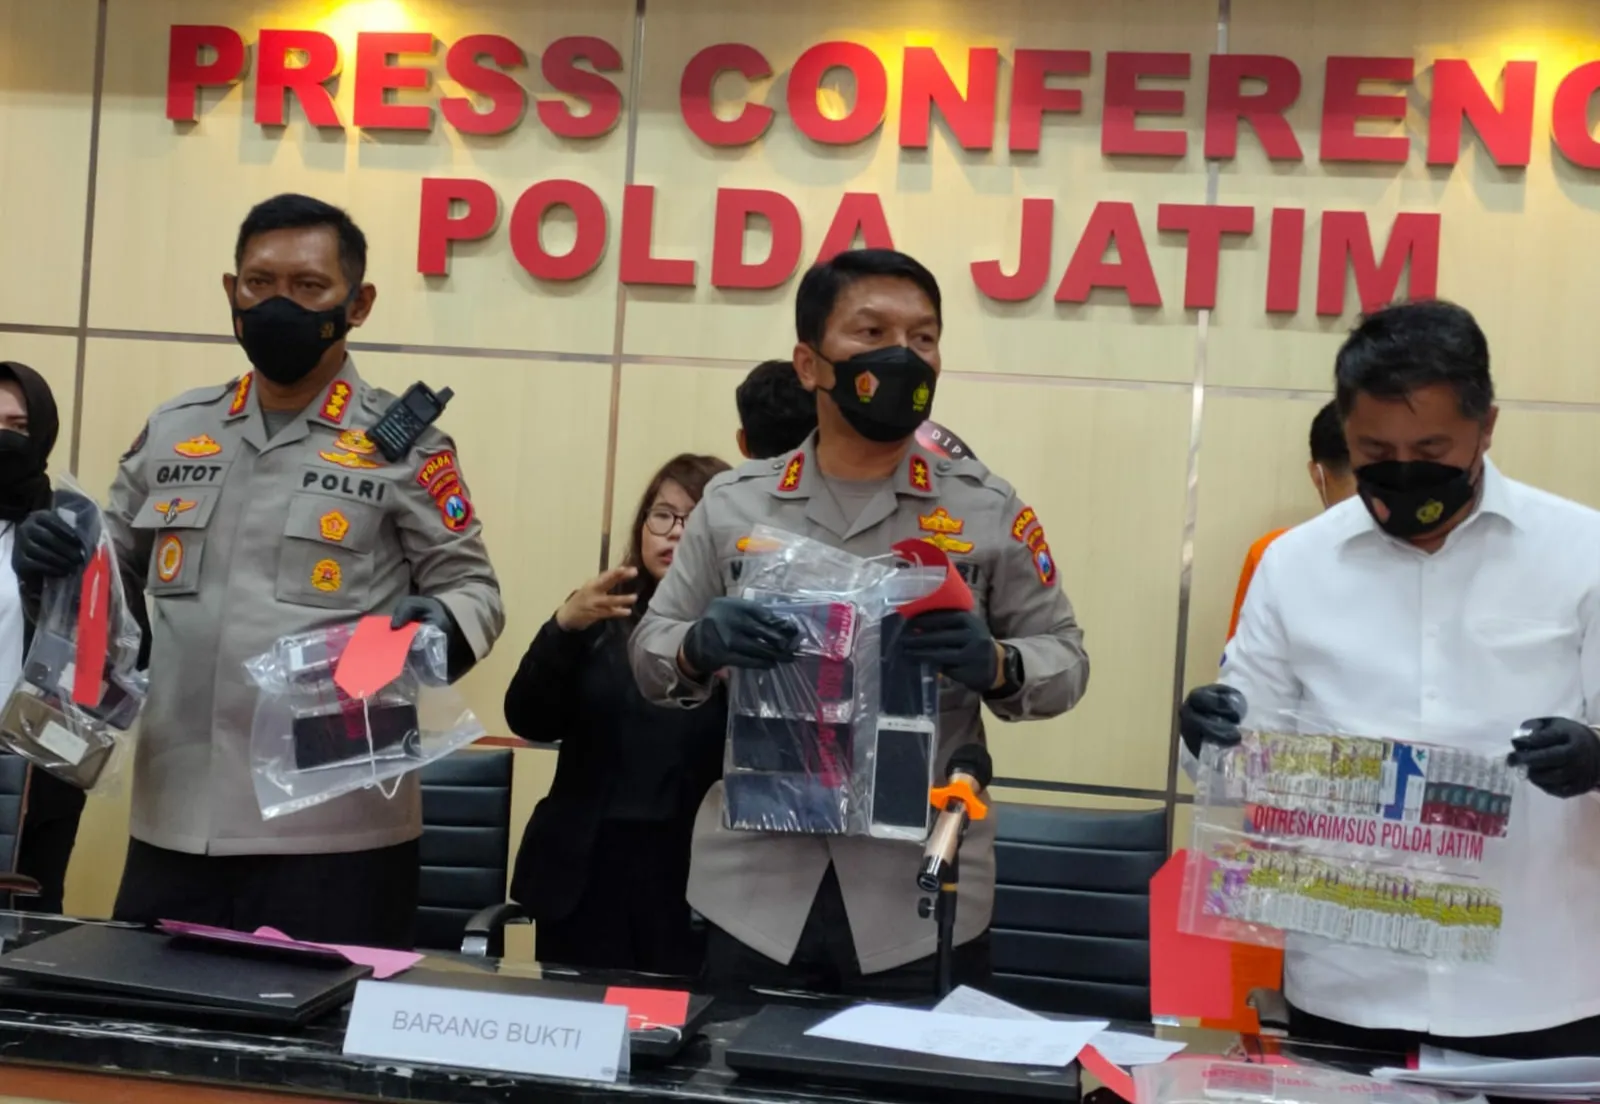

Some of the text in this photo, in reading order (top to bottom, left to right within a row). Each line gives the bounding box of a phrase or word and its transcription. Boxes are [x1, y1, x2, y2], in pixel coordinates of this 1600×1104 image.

[166, 24, 1600, 169] PRESS CONFERENC
[417, 177, 1441, 316] POLDA JATIM
[931, 429, 970, 460] DIP
[156, 465, 222, 484] GATOT
[303, 472, 385, 501] POLRI
[421, 455, 452, 482] POLDA
[1253, 804, 1485, 862] DITRESKRIMSUS POLDA JATIM
[392, 1010, 582, 1051] BARANG BUKTI
